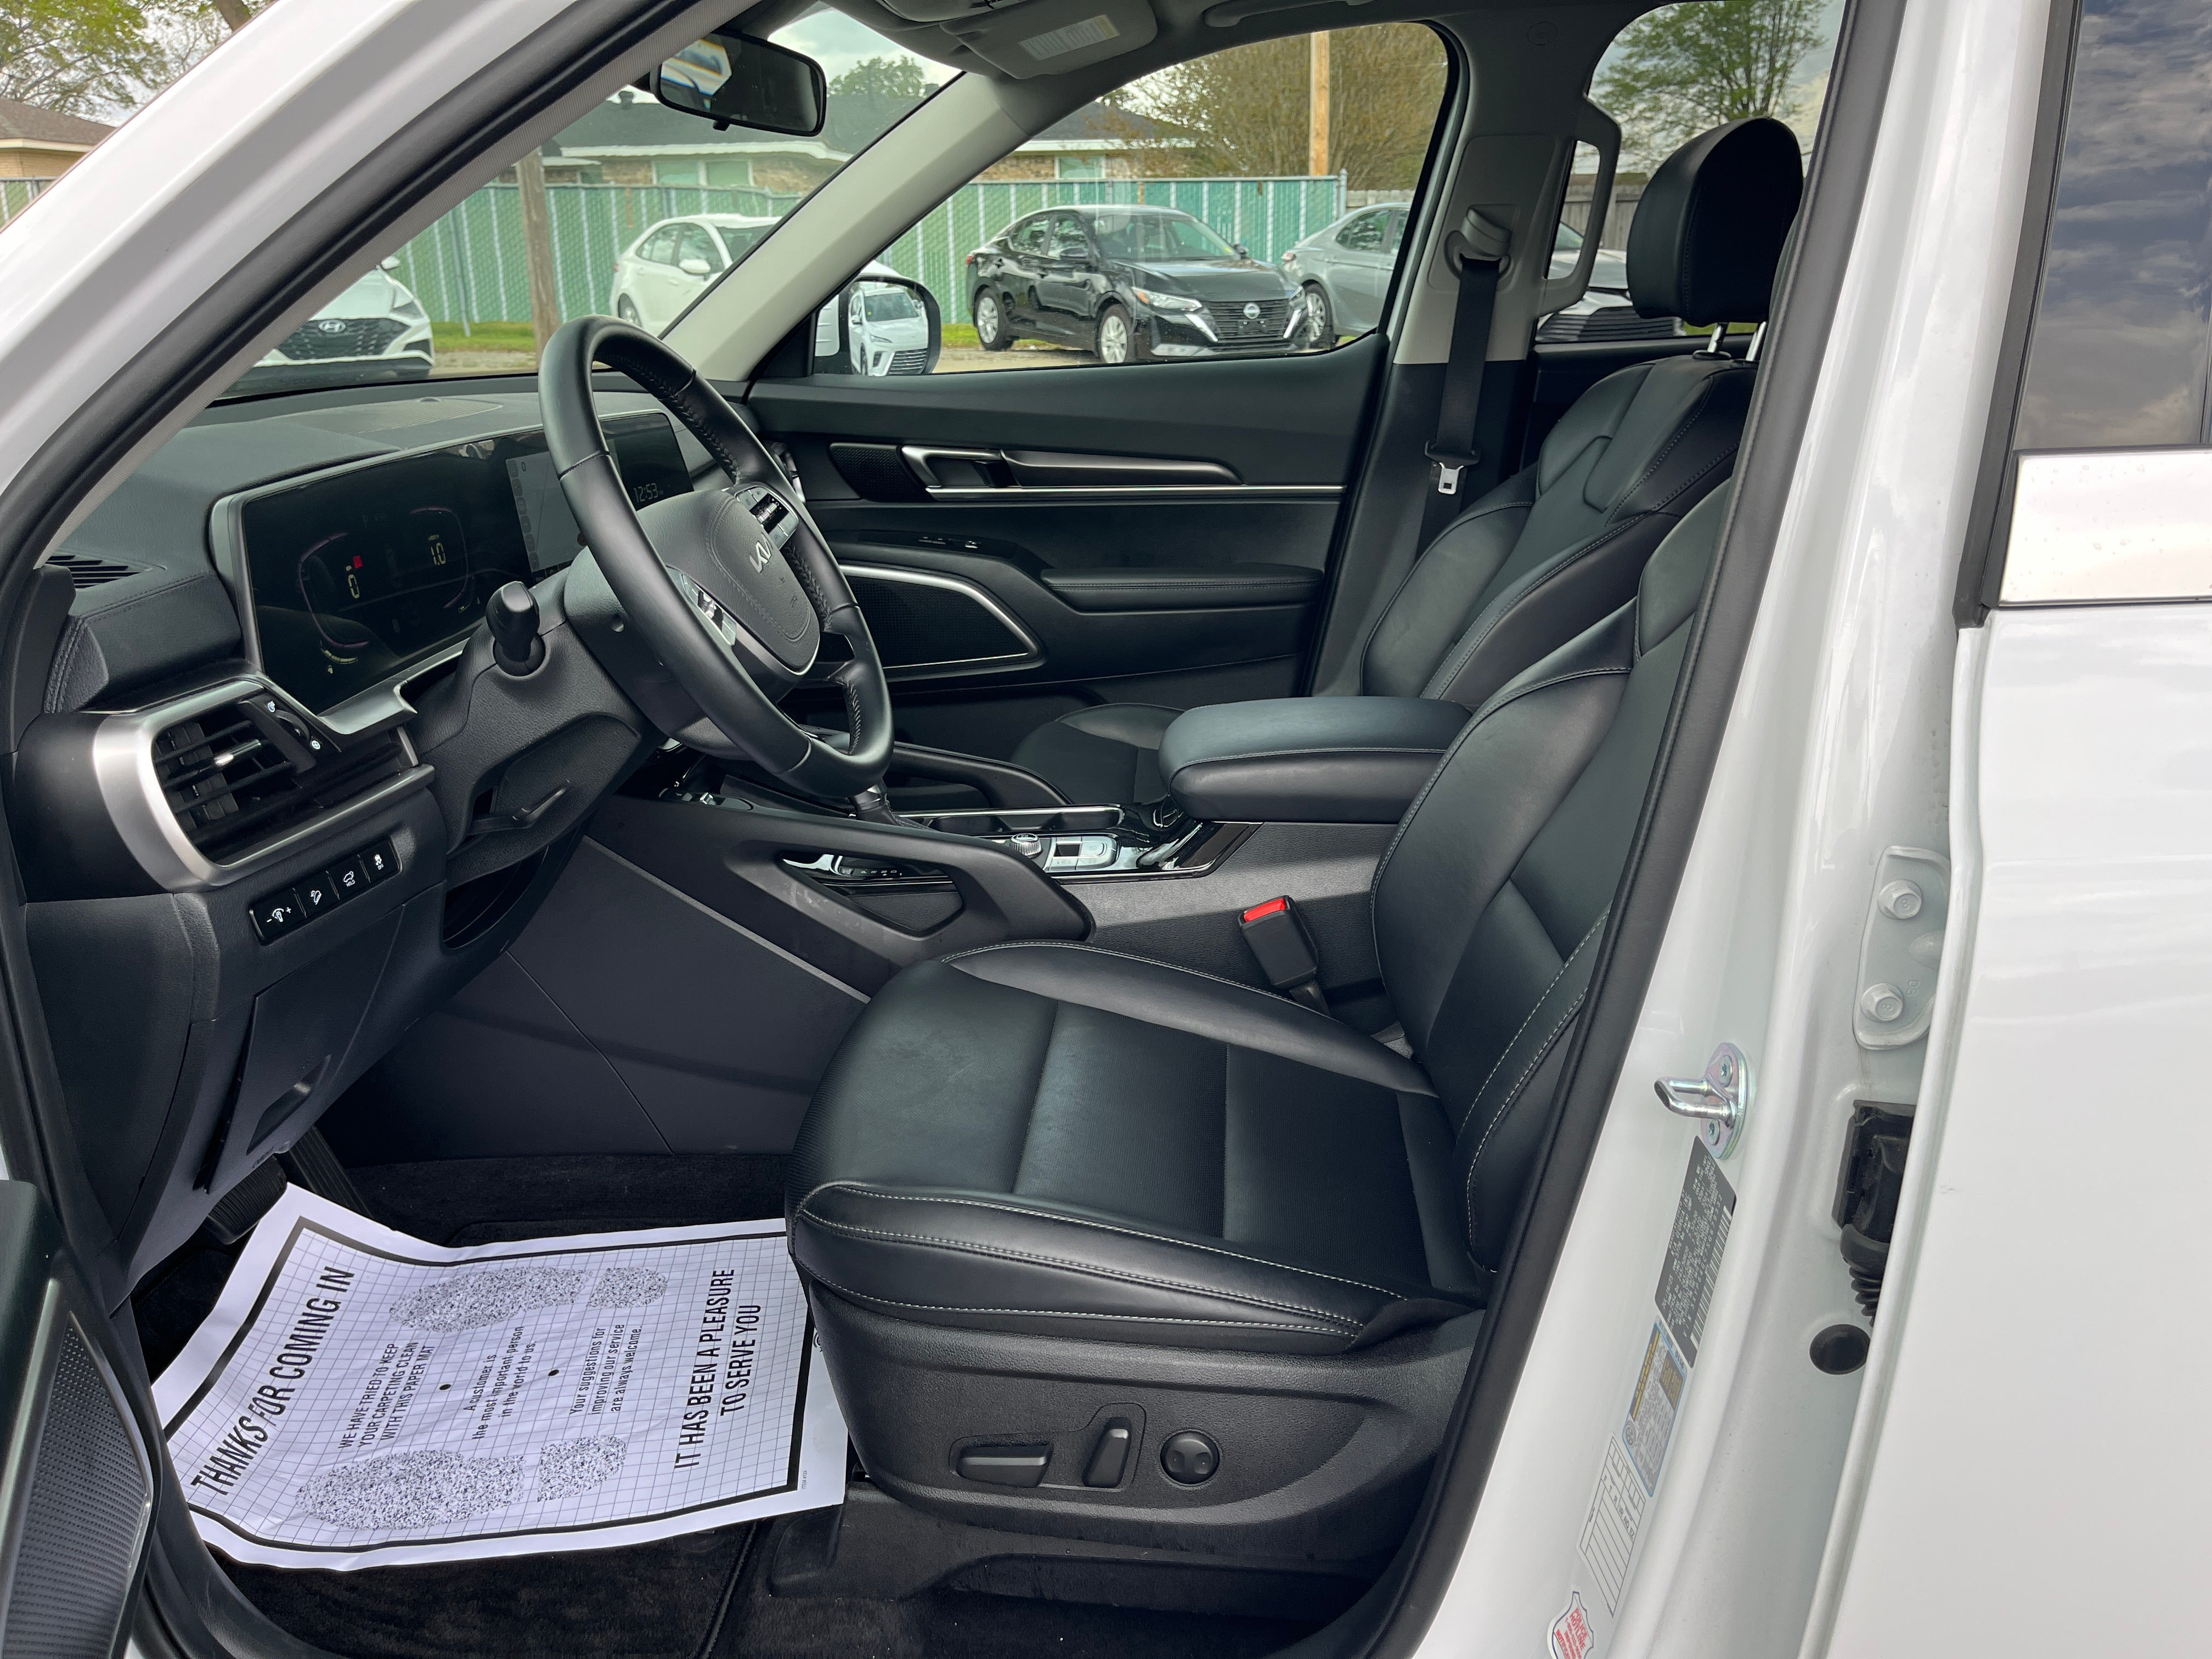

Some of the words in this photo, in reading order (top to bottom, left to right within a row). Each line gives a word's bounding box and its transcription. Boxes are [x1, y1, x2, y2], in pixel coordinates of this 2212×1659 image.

[633, 483, 658, 503] 12:53
[348, 574, 360, 599] 0
[315, 1266, 354, 1293] IN
[699, 1269, 735, 1342] PLEASURE
[735, 1305, 761, 1335] YOU
[269, 1298, 342, 1379] COMING
[524, 1341, 537, 1353] us.
[608, 1324, 624, 1353] service
[624, 1326, 642, 1364] welcome.
[697, 1347, 720, 1357] A
[380, 1344, 399, 1363] KEEP
[518, 1355, 532, 1364] to
[604, 1356, 616, 1369] our
[725, 1339, 756, 1390] SERVE
[373, 1367, 388, 1377] TO
[470, 1365, 493, 1403] customer
[472, 1424, 488, 1440] the
[481, 1398, 498, 1420] most
[492, 1355, 514, 1396] important
[507, 1326, 524, 1354] person
[512, 1367, 528, 1390] world
[569, 1395, 586, 1414] Your
[579, 1341, 602, 1391] suggestions
[592, 1328, 606, 1339] for
[614, 1365, 633, 1394] always
[687, 1363, 718, 1406] BEEN
[247, 1385, 296, 1426] FOR
[358, 1420, 381, 1447] YOUR
[373, 1369, 405, 1418] CARPETING
[396, 1342, 419, 1368] CLEAN
[359, 1380, 382, 1406] TRIED
[380, 1416, 403, 1441] WITH
[392, 1393, 413, 1413] THIS
[403, 1363, 426, 1391] PAPER
[417, 1346, 435, 1361] MAT
[503, 1392, 518, 1406] the
[588, 1372, 614, 1415] improving
[611, 1397, 623, 1412] are
[720, 1392, 747, 1416] TO
[347, 1408, 369, 1430] HAVE
[498, 1408, 512, 1417] in
[338, 1432, 356, 1448] WE
[679, 1409, 709, 1446] HAS
[190, 1415, 268, 1496] THANKS
[674, 1453, 701, 1469] IT
[1570, 1612, 1585, 1651] HOTLINE
[1574, 1608, 1588, 1640] POLICE
